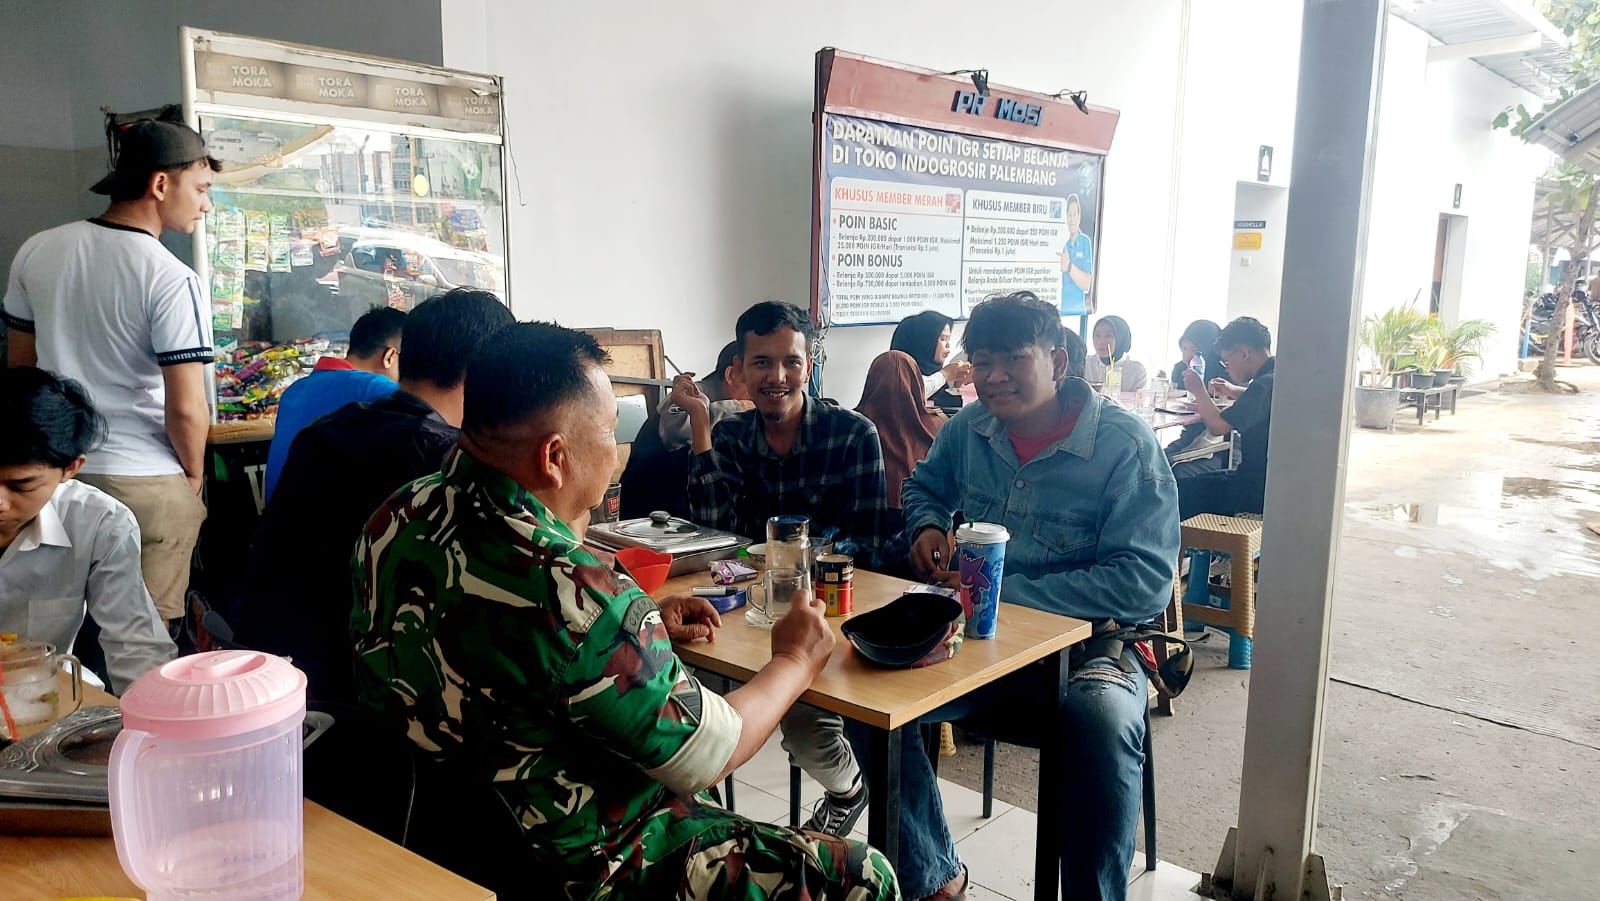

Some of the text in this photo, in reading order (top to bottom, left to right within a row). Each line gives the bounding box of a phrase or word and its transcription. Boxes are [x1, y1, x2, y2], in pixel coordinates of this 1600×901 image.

[232, 66, 268, 76] TORA
[232, 78, 272, 88] MOKA
[318, 77, 352, 87] TORA
[318, 87, 356, 98] MOKA
[394, 87, 424, 97] TORA
[394, 98, 428, 107] MOKA
[464, 96, 490, 106] TORA
[951, 90, 986, 116] PR
[464, 107, 494, 115] MOKA
[831, 121, 1069, 169] DAPATKAN POIN IGR SETIAP BELANJA
[832, 145, 1057, 186] DI TOKO INDOGROSIR PALEMBANG
[834, 186, 944, 207] KHUSUS MEMBER MERAH
[972, 198, 1048, 214] KHUSUS MEMBER BIRU
[840, 214, 898, 231] POIN BASIC
[838, 254, 903, 268] POIN BONUS
